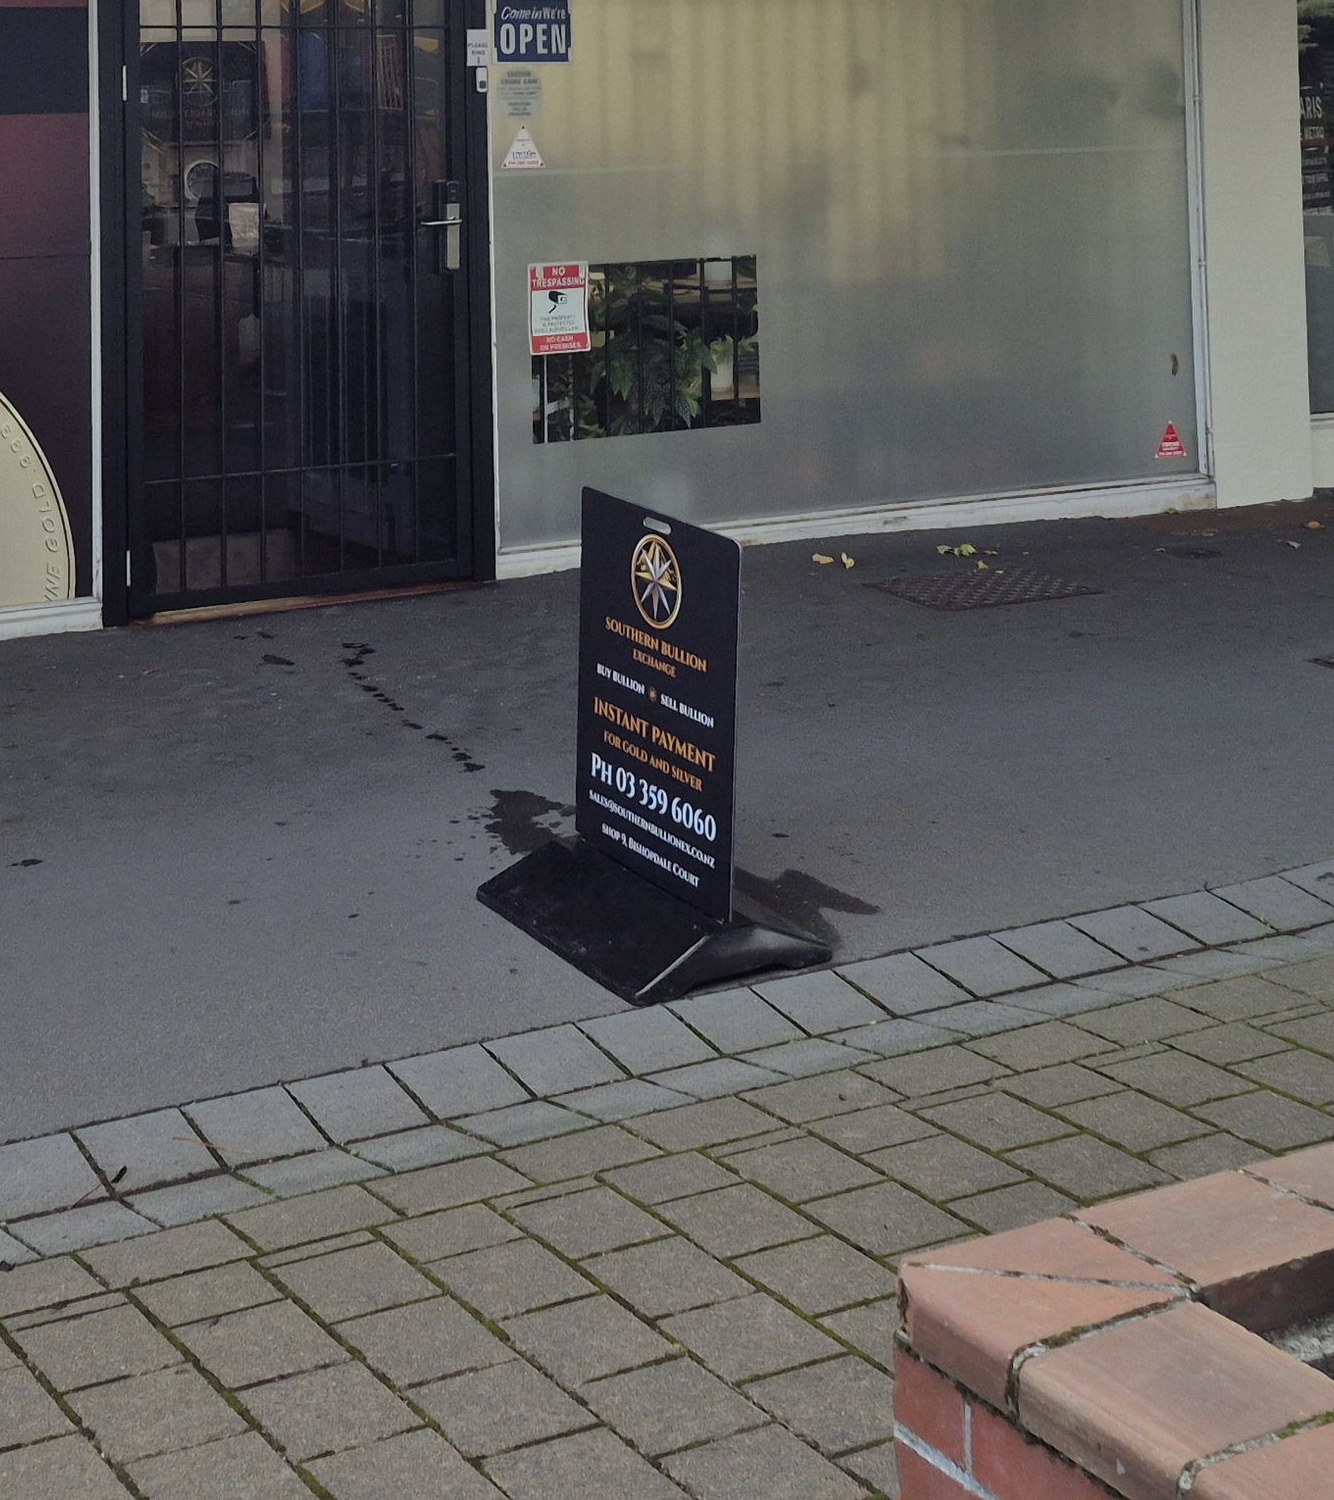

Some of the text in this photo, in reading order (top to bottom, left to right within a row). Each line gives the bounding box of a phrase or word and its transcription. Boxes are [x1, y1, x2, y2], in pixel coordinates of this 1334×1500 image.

[499, 22, 567, 55] OPEN
[531, 276, 585, 289] TRESPASSING
[551, 266, 566, 276] NO
[31, 483, 60, 553] GOLD
[605, 616, 708, 673] SOUTHERN BULLION
[632, 648, 677, 678] EXCHANGE
[596, 662, 645, 695] BUY BULLION
[593, 696, 716, 772] INSTANT PAYMENT
[660, 693, 714, 729] SELL BULLION
[603, 730, 704, 792] FOR GOLD AND SILVER
[591, 752, 717, 842] PH 03 359 6060
[601, 822, 621, 841] SHOP
[628, 836, 672, 872] BISHOPDALE
[672, 862, 700, 888] COURT
